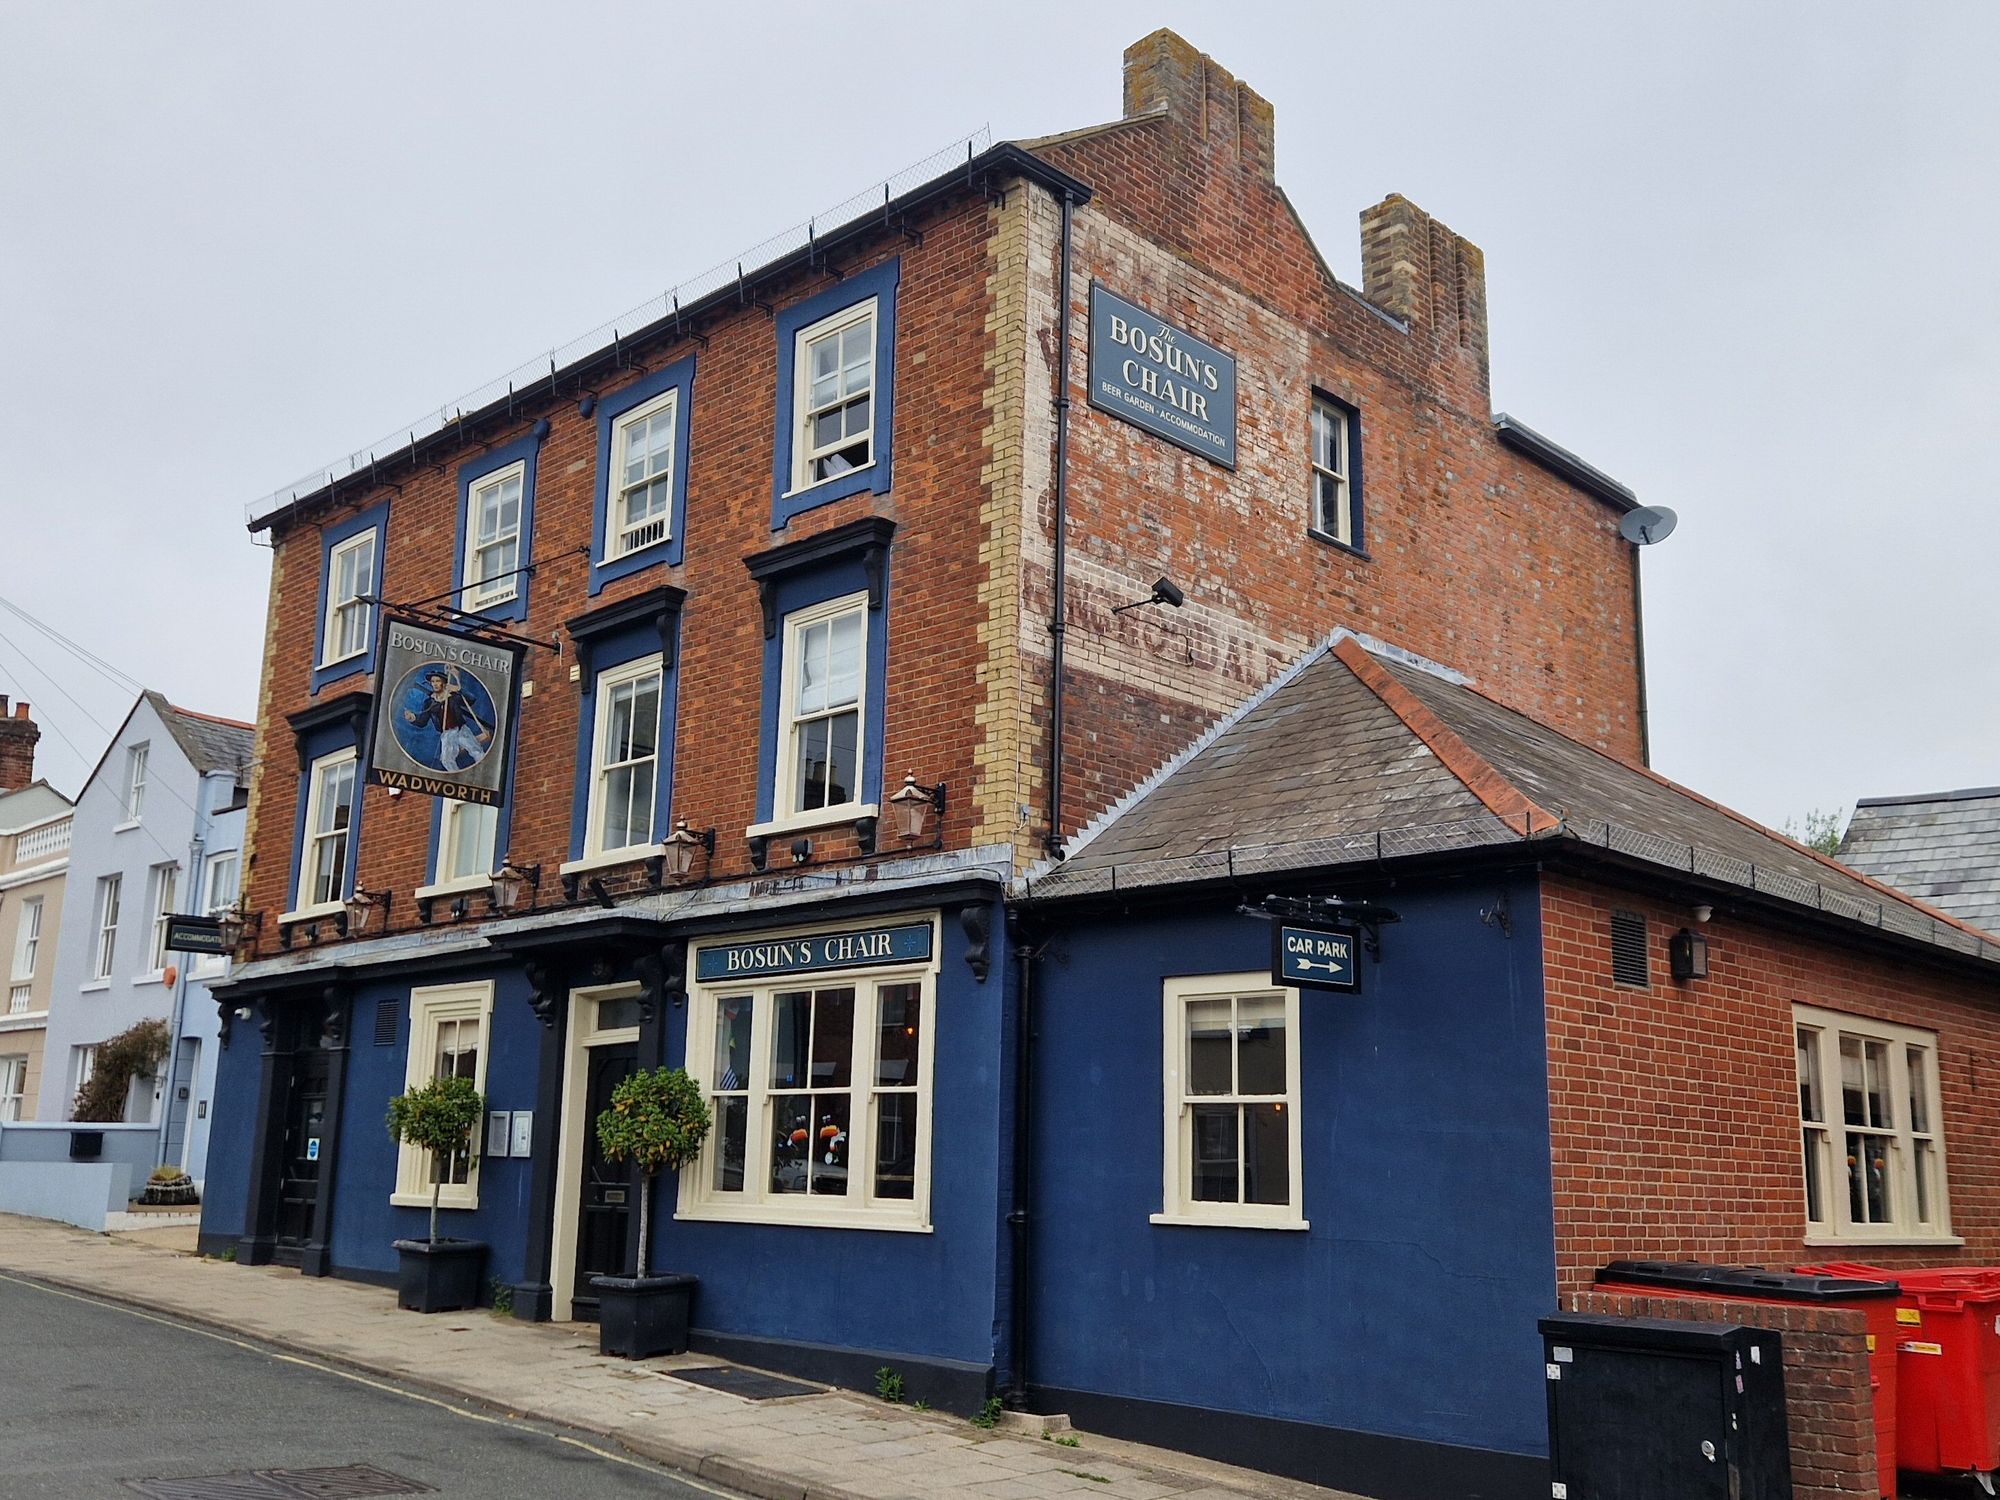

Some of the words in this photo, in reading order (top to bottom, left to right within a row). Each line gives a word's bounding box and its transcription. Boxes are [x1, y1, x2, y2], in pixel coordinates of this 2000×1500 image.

[1110, 314, 1218, 391] BOSUN'S
[1155, 325, 1177, 344] The
[1122, 359, 1210, 423] CHAIR
[1102, 381, 1122, 399] BEER
[1124, 393, 1154, 413] GARDEN
[1159, 410, 1226, 447] ACCOMMODATION
[391, 631, 457, 662] BOSUN'S
[460, 649, 510, 674] CHAIR
[378, 770, 491, 803] WADWORTH
[726, 941, 811, 971] BOSUN'S
[824, 933, 893, 961] CHAIR
[1287, 936, 1313, 954] CAR
[1317, 940, 1348, 959] PARK
